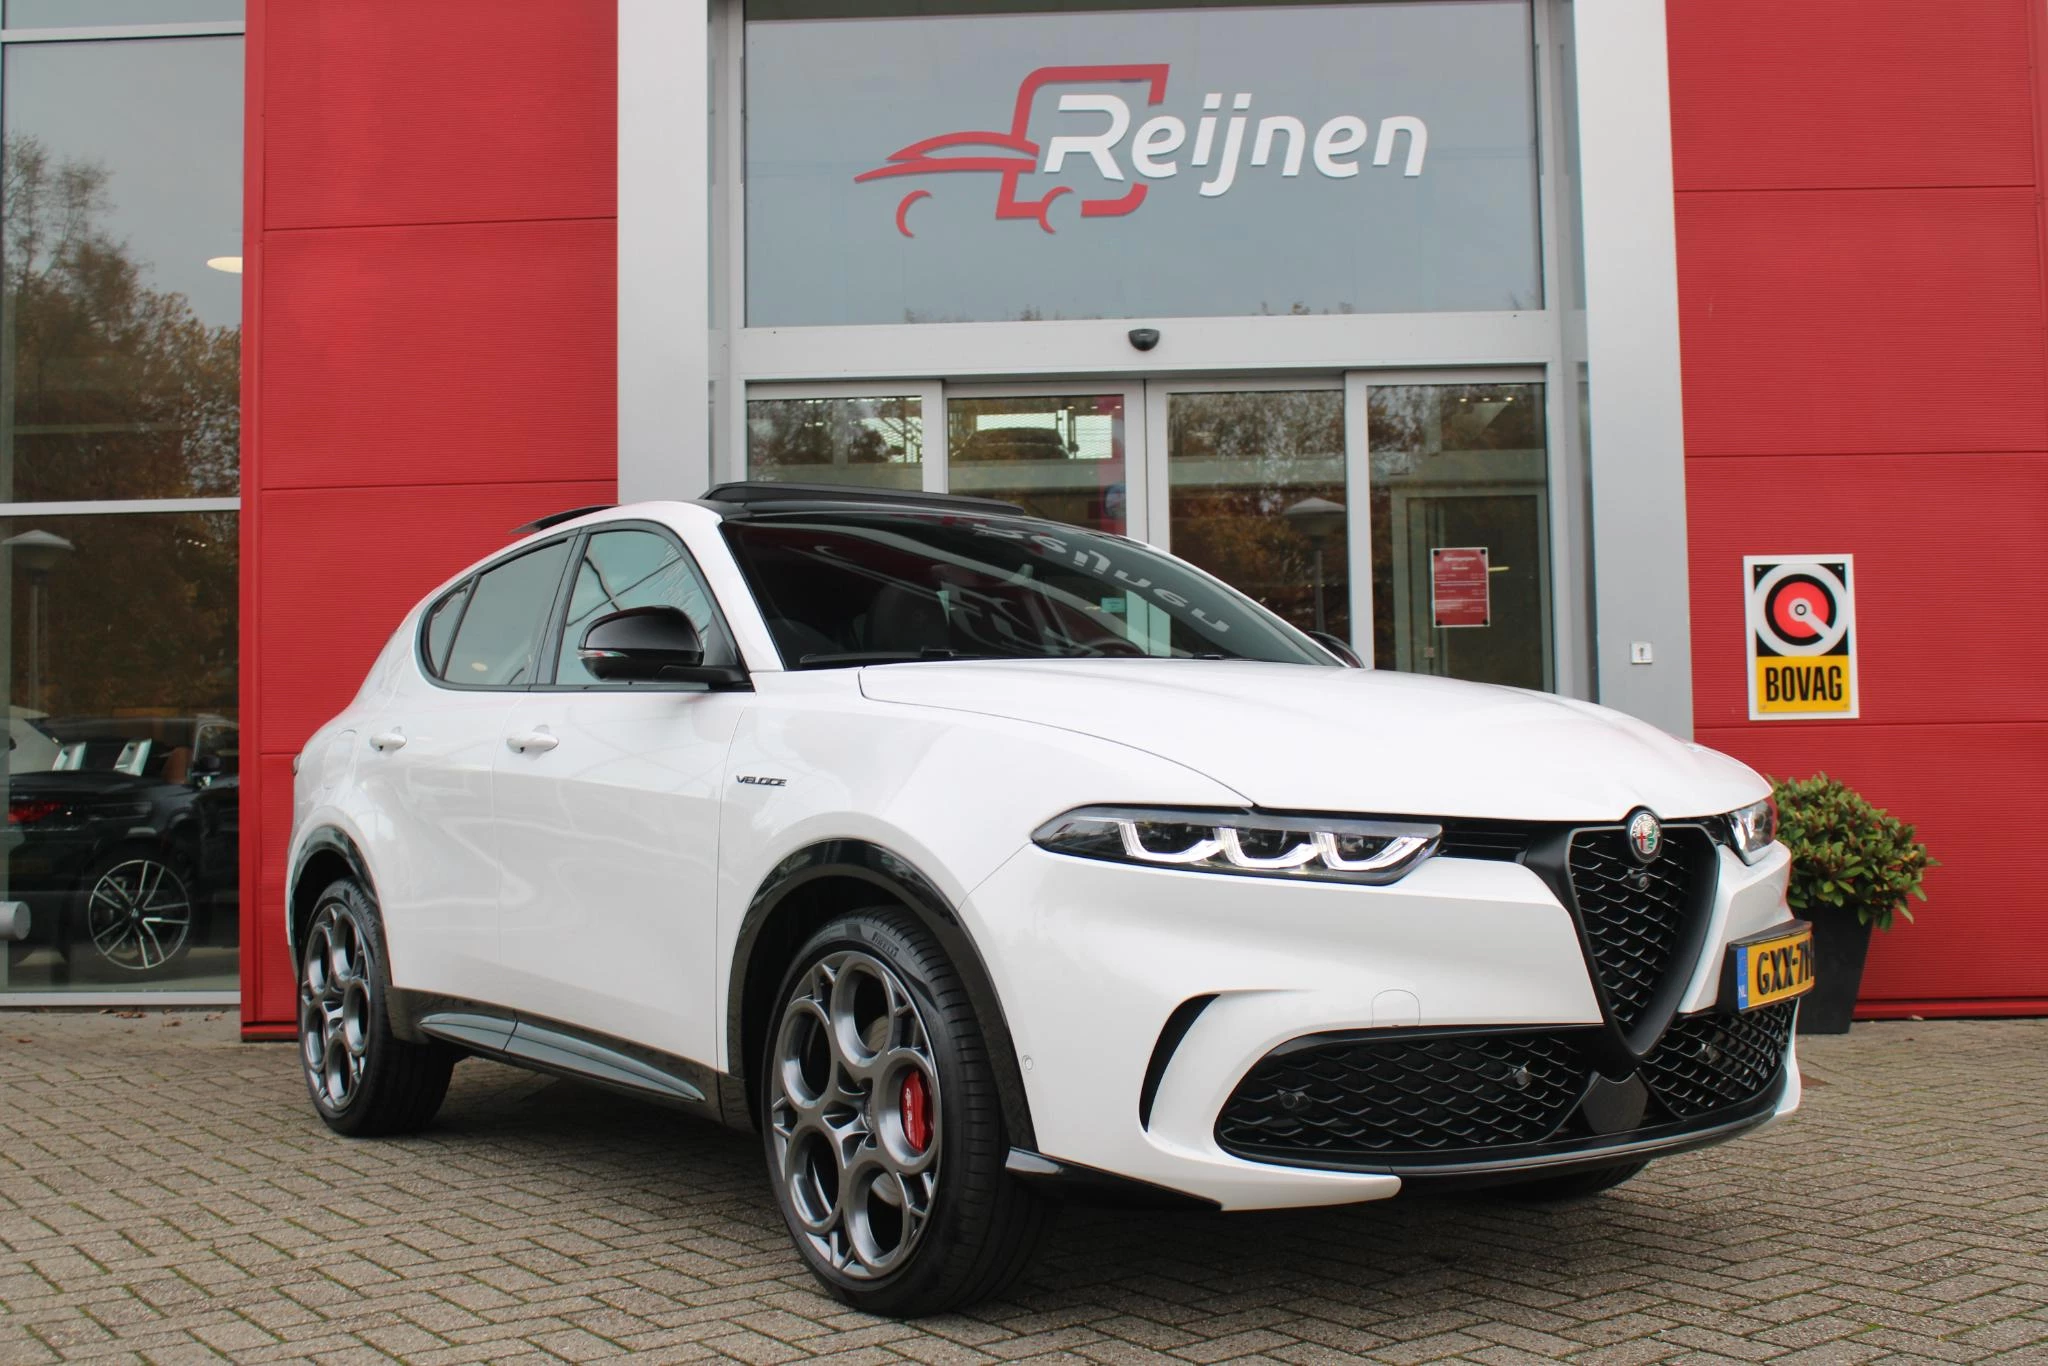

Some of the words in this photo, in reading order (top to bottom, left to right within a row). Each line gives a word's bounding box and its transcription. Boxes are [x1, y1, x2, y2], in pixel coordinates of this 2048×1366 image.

[1044, 93, 1428, 197] Reijnen
[1765, 666, 1842, 702] BOVAG
[736, 775, 787, 787] VELOCE
